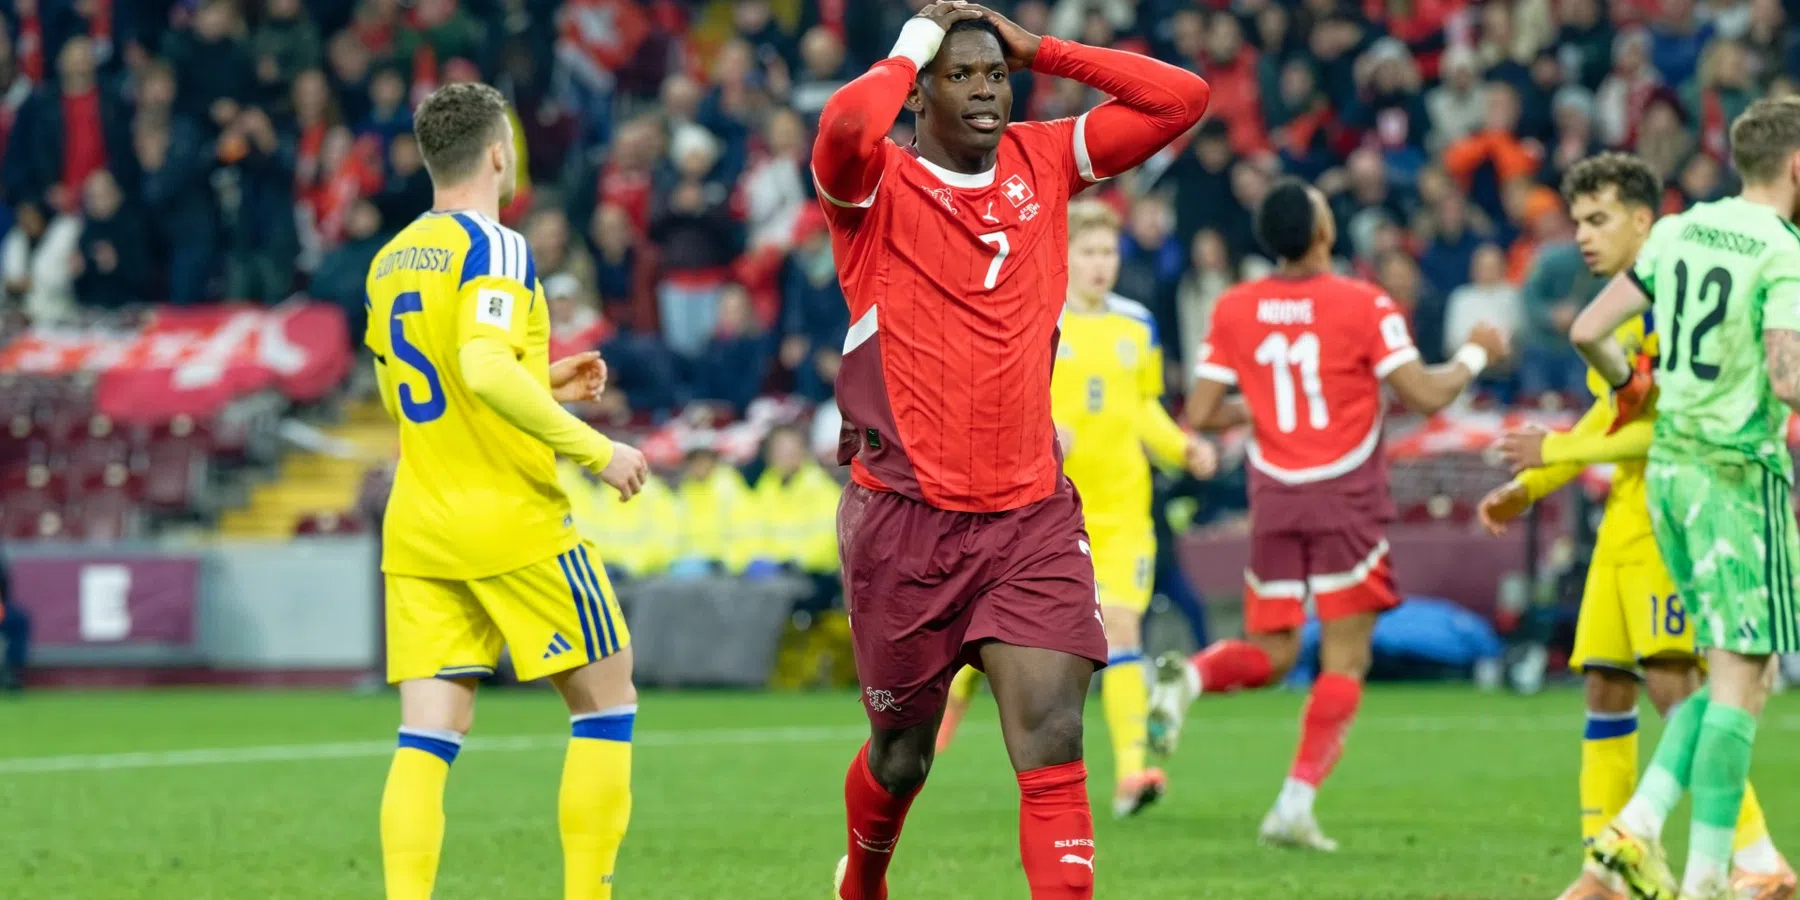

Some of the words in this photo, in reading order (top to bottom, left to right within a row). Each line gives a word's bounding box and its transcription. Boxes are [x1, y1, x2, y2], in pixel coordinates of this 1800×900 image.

[978, 231, 1010, 289] 7
[390, 291, 447, 423] 5
[1666, 259, 1732, 381] 12
[1255, 332, 1330, 433] 11
[1651, 594, 1685, 637] 18
